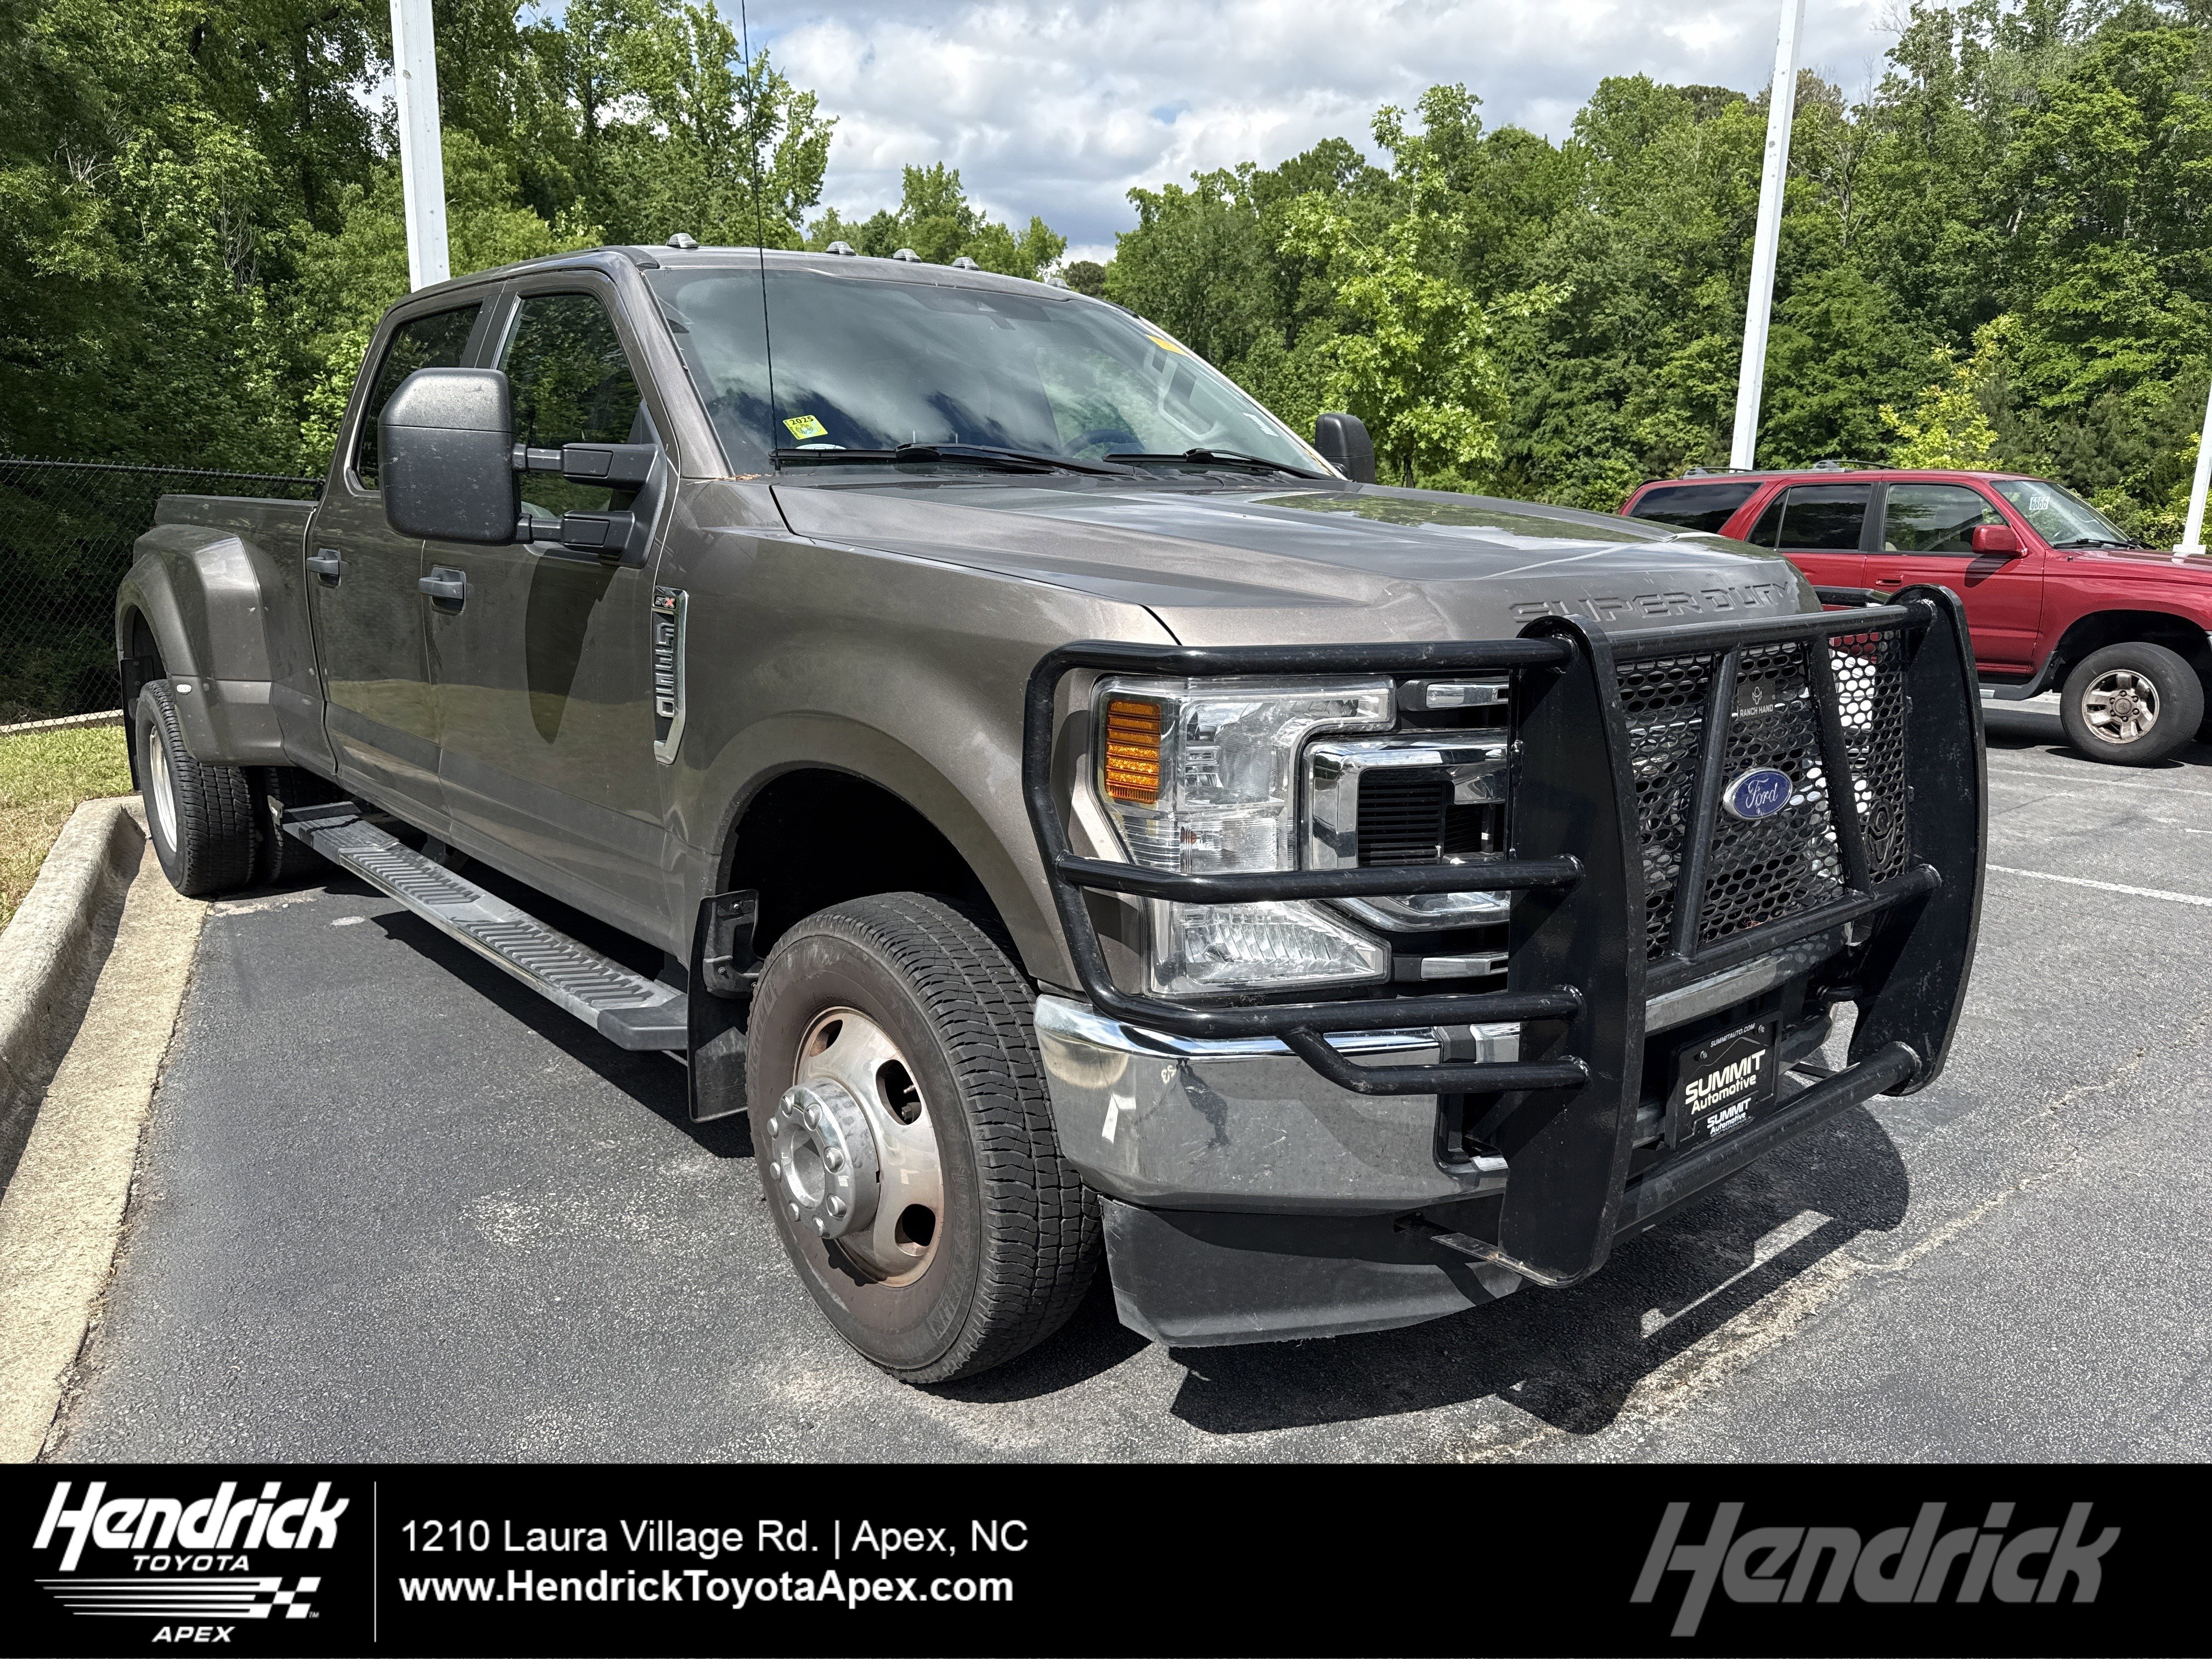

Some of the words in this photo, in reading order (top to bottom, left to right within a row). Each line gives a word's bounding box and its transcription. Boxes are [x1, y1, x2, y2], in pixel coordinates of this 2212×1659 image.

[789, 416, 814, 425] 2025
[2031, 497, 2047, 509] 6866
[655, 597, 675, 609] STX
[1509, 592, 1702, 623] SUPER
[1701, 582, 1788, 612] DUTY
[1740, 707, 1758, 718] RANCH
[1758, 704, 1774, 714] HAND
[1746, 777, 1778, 809] Ford
[1710, 1023, 1756, 1048] SUMMITAUTO.COM
[1685, 1049, 1766, 1104] SUMMIT
[1691, 1074, 1757, 1115] Automotive
[1707, 1097, 1751, 1129] SUMMIT
[1710, 1112, 1746, 1135] Automotive
